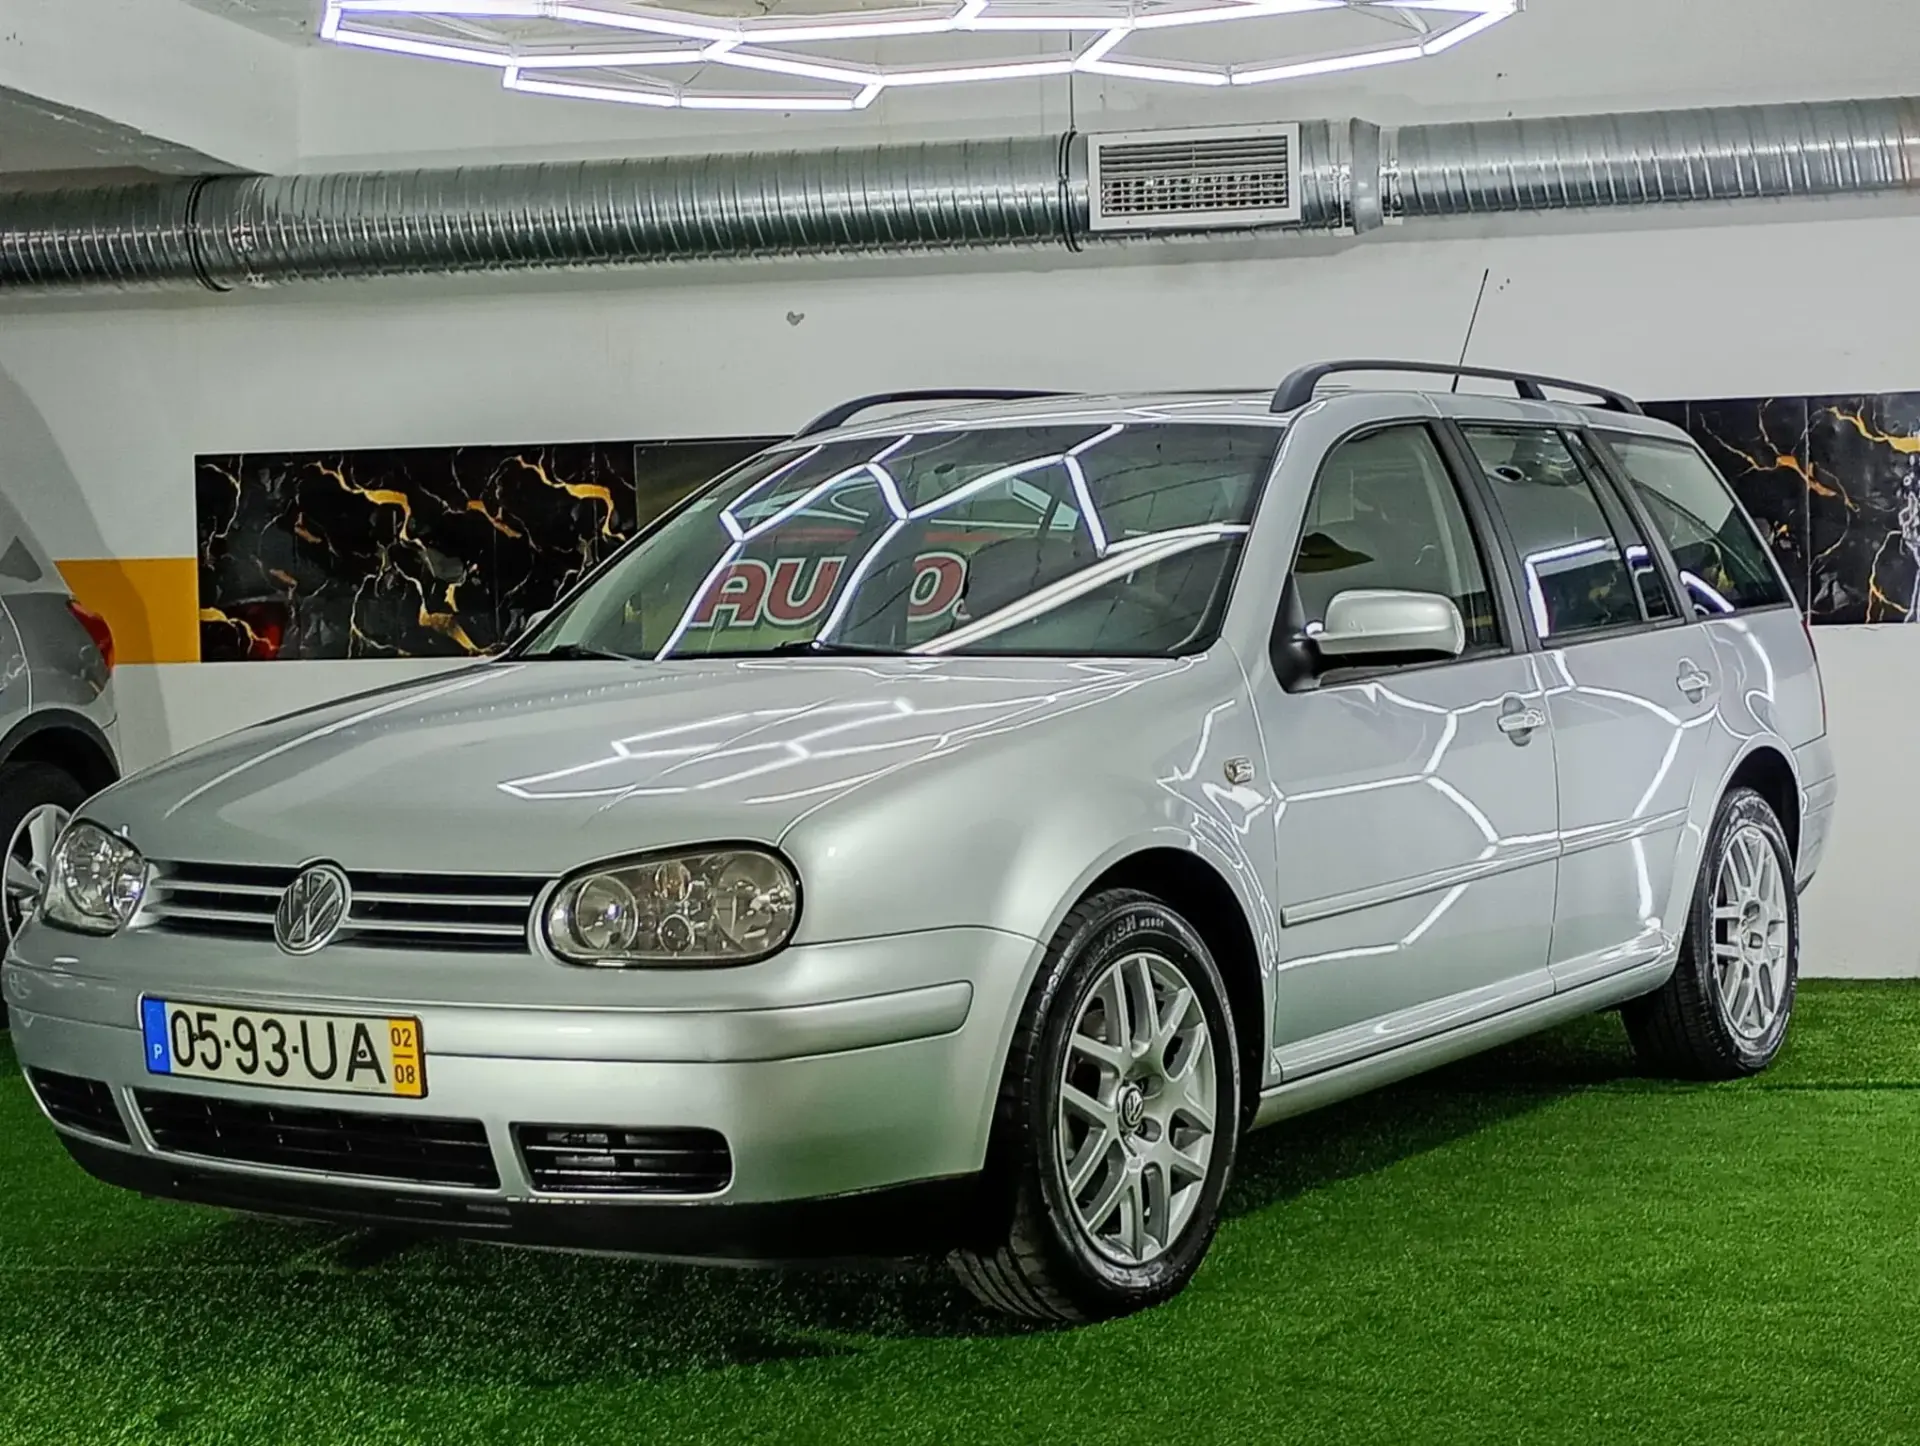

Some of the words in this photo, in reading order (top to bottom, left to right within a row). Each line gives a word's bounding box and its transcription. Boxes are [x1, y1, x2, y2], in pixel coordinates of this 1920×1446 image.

[391, 1027, 412, 1047] 02
[152, 1045, 162, 1059] P
[394, 1064, 415, 1084] 08
